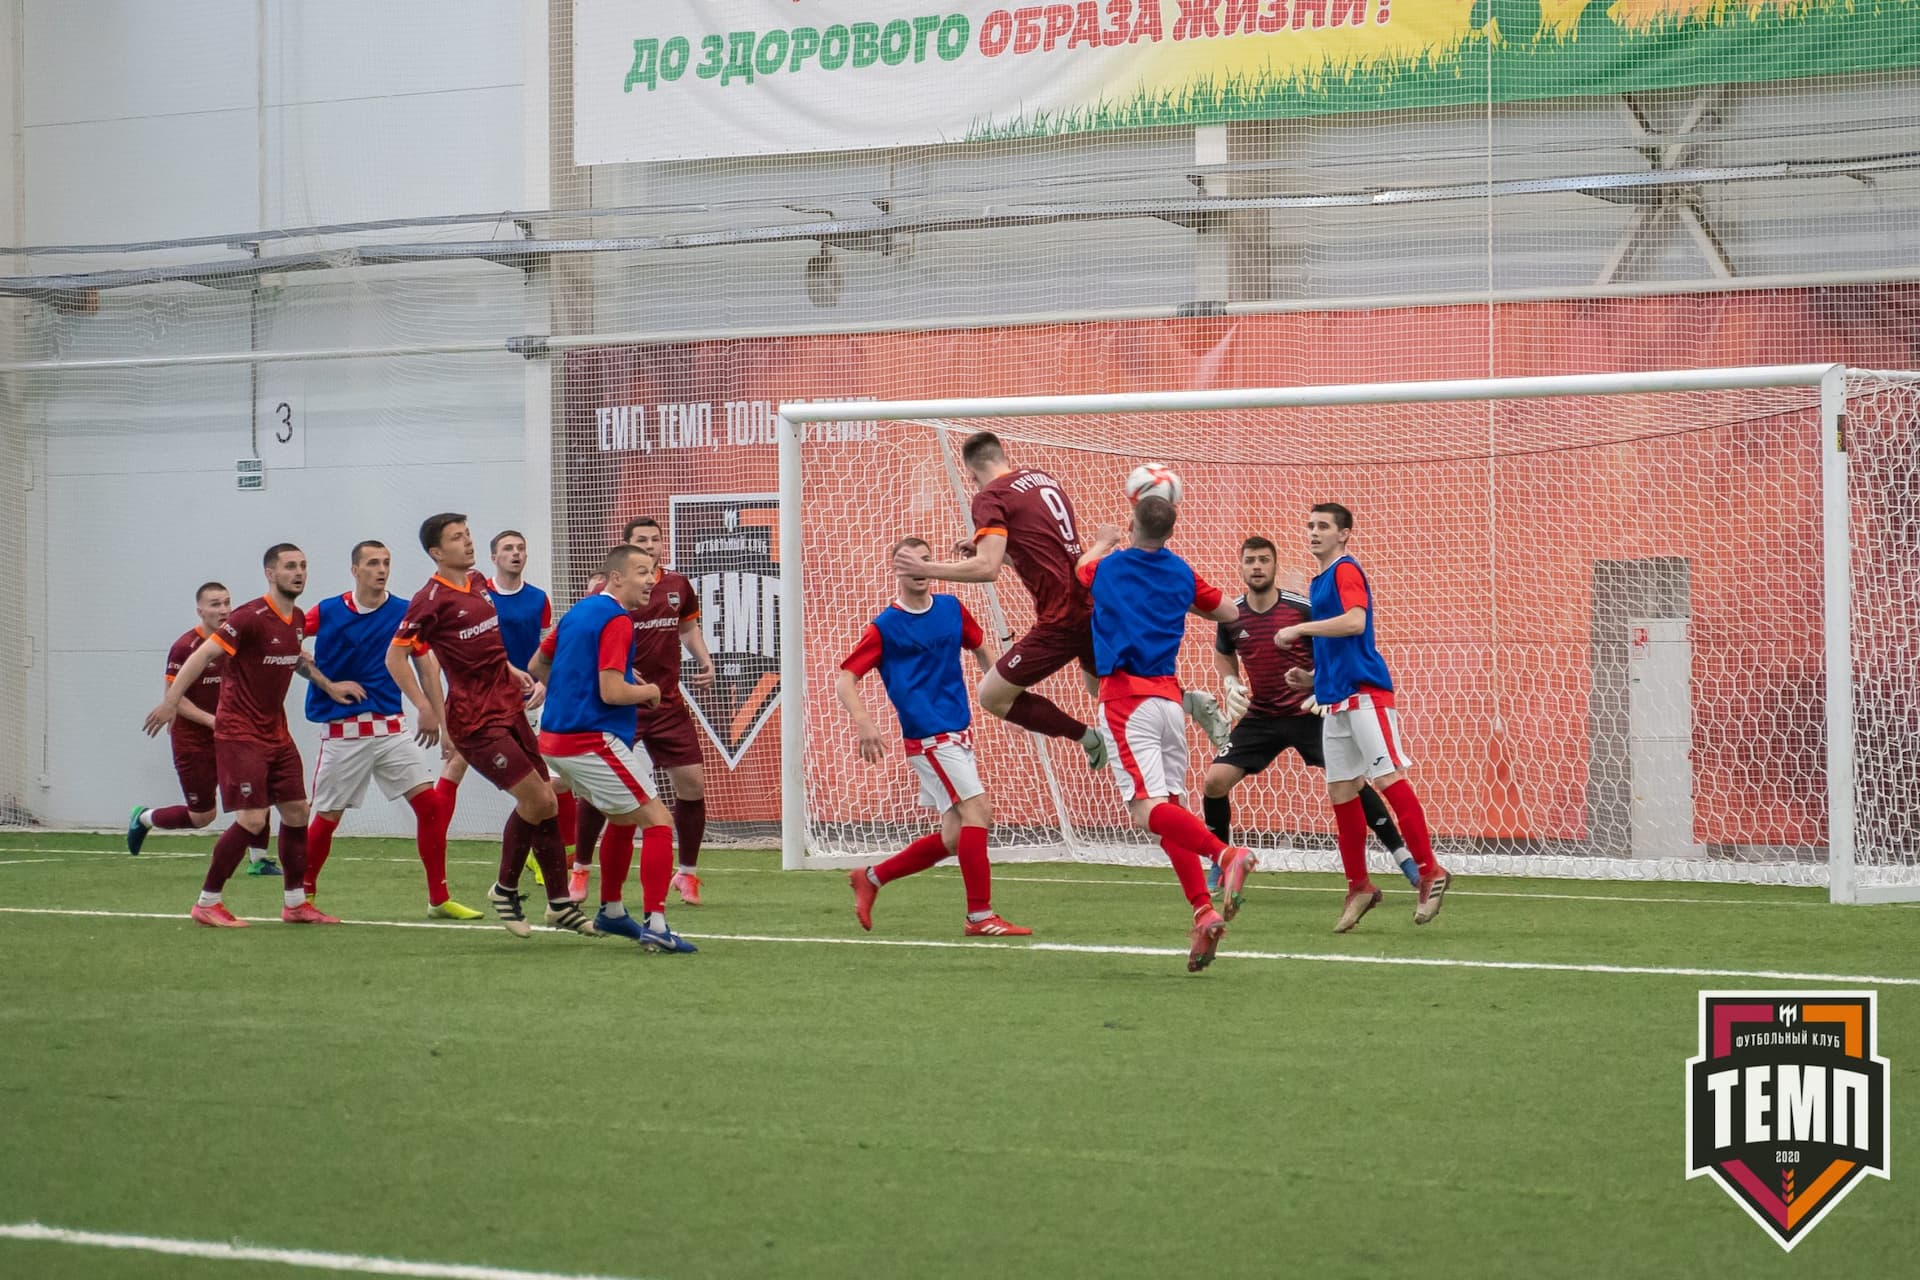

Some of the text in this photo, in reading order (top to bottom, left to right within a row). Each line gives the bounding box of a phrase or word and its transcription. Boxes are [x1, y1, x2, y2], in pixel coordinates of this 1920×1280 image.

[624, 36, 690, 93] ДО
[696, 13, 970, 87] ЗДОРОВОГО
[979, 1, 1163, 57] ОБРАЗА
[276, 402, 293, 444] 3
[657, 403, 718, 451] ТЕМП,
[1040, 487, 1075, 541] 9
[682, 572, 781, 660] ЕМП
